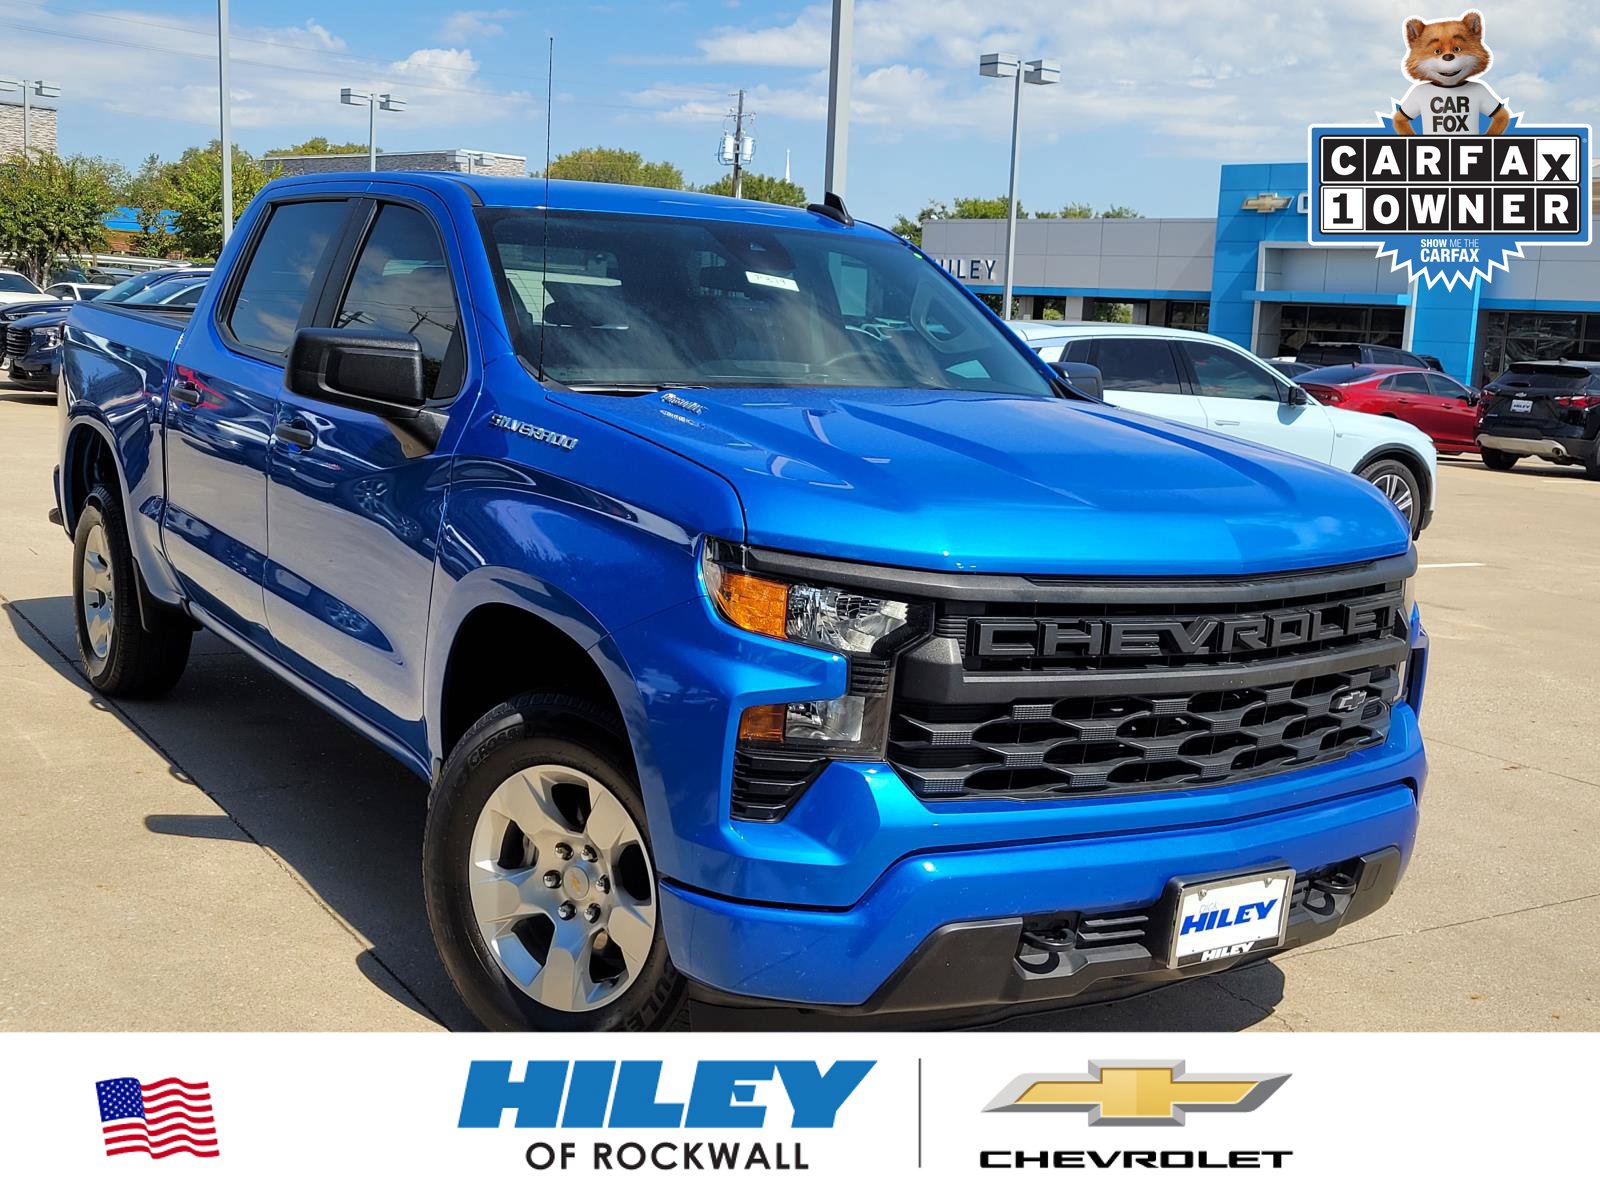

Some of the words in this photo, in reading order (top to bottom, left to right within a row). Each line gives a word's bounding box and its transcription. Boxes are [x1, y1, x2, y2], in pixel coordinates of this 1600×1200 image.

[934, 259, 996, 279] ILEY
[489, 413, 578, 450] SILVERADO
[967, 603, 1395, 657] CHEVROLET
[1180, 898, 1278, 936] HILEY
[1200, 941, 1255, 962] HILEY
